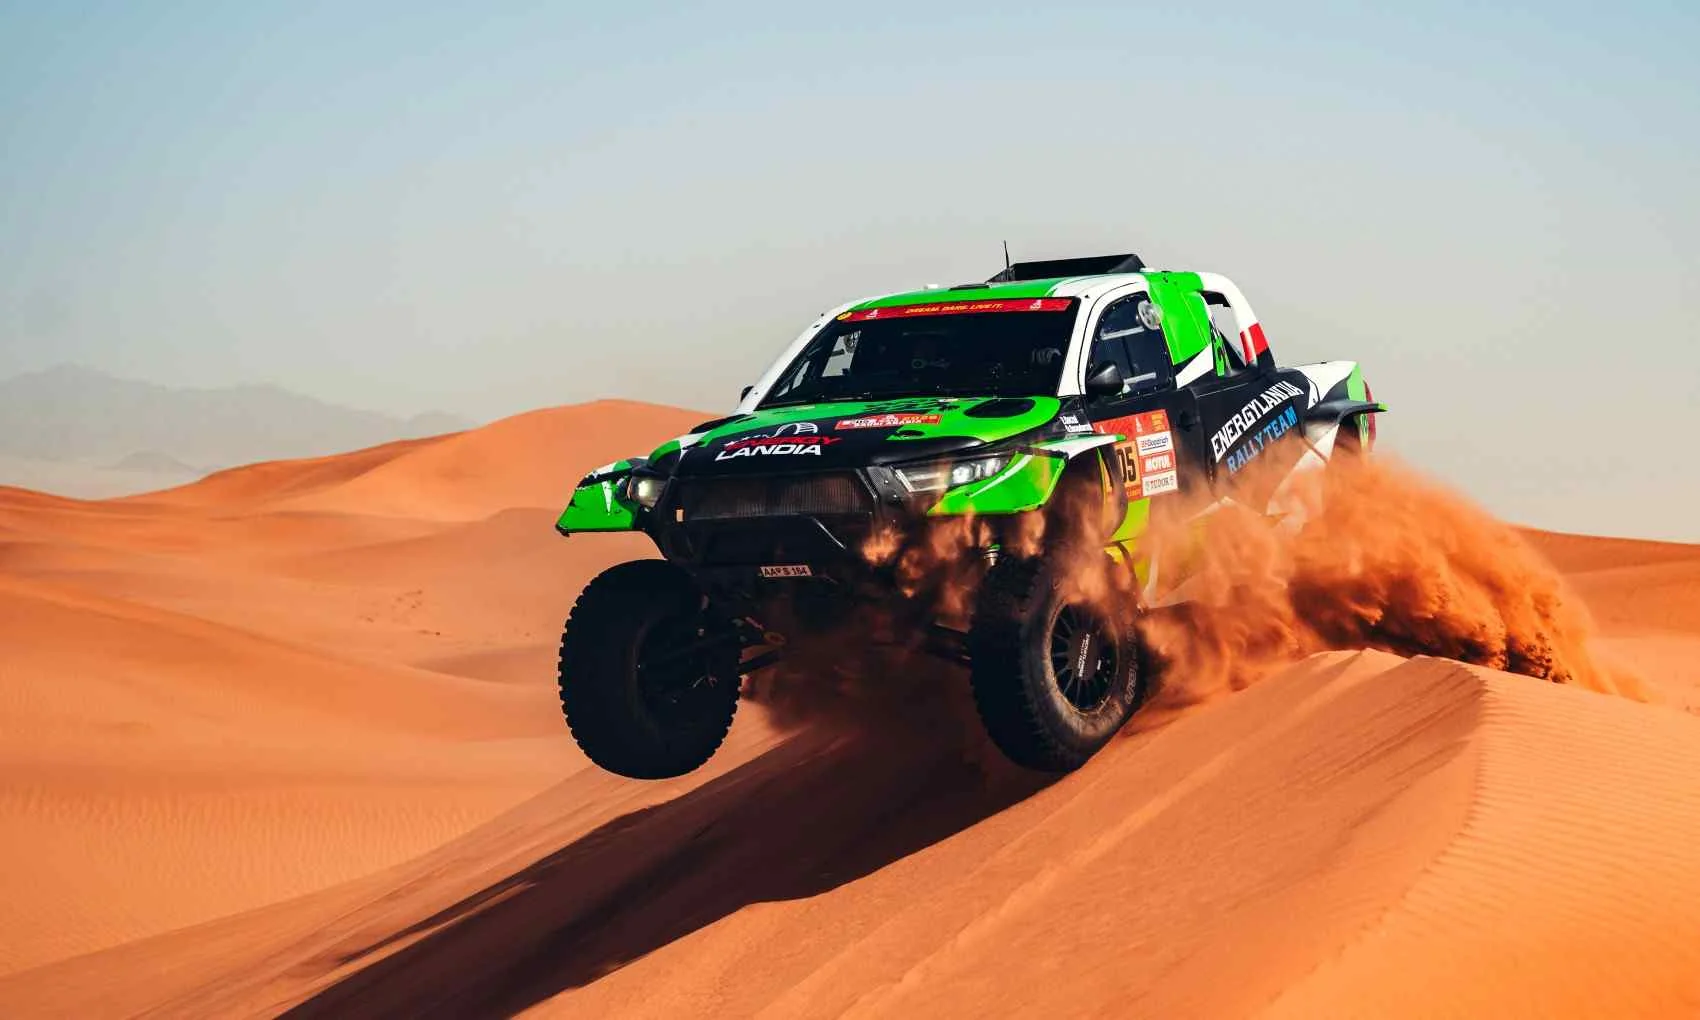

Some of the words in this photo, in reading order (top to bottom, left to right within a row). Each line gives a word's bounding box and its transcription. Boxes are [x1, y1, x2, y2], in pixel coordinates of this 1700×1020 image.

[1211, 380, 1304, 463] ENERGYLANDIA
[1226, 432, 1265, 474] RALLY
[1264, 405, 1298, 443] TEAM
[715, 444, 821, 461] LANDIA
[1145, 454, 1170, 472] MOTUL
